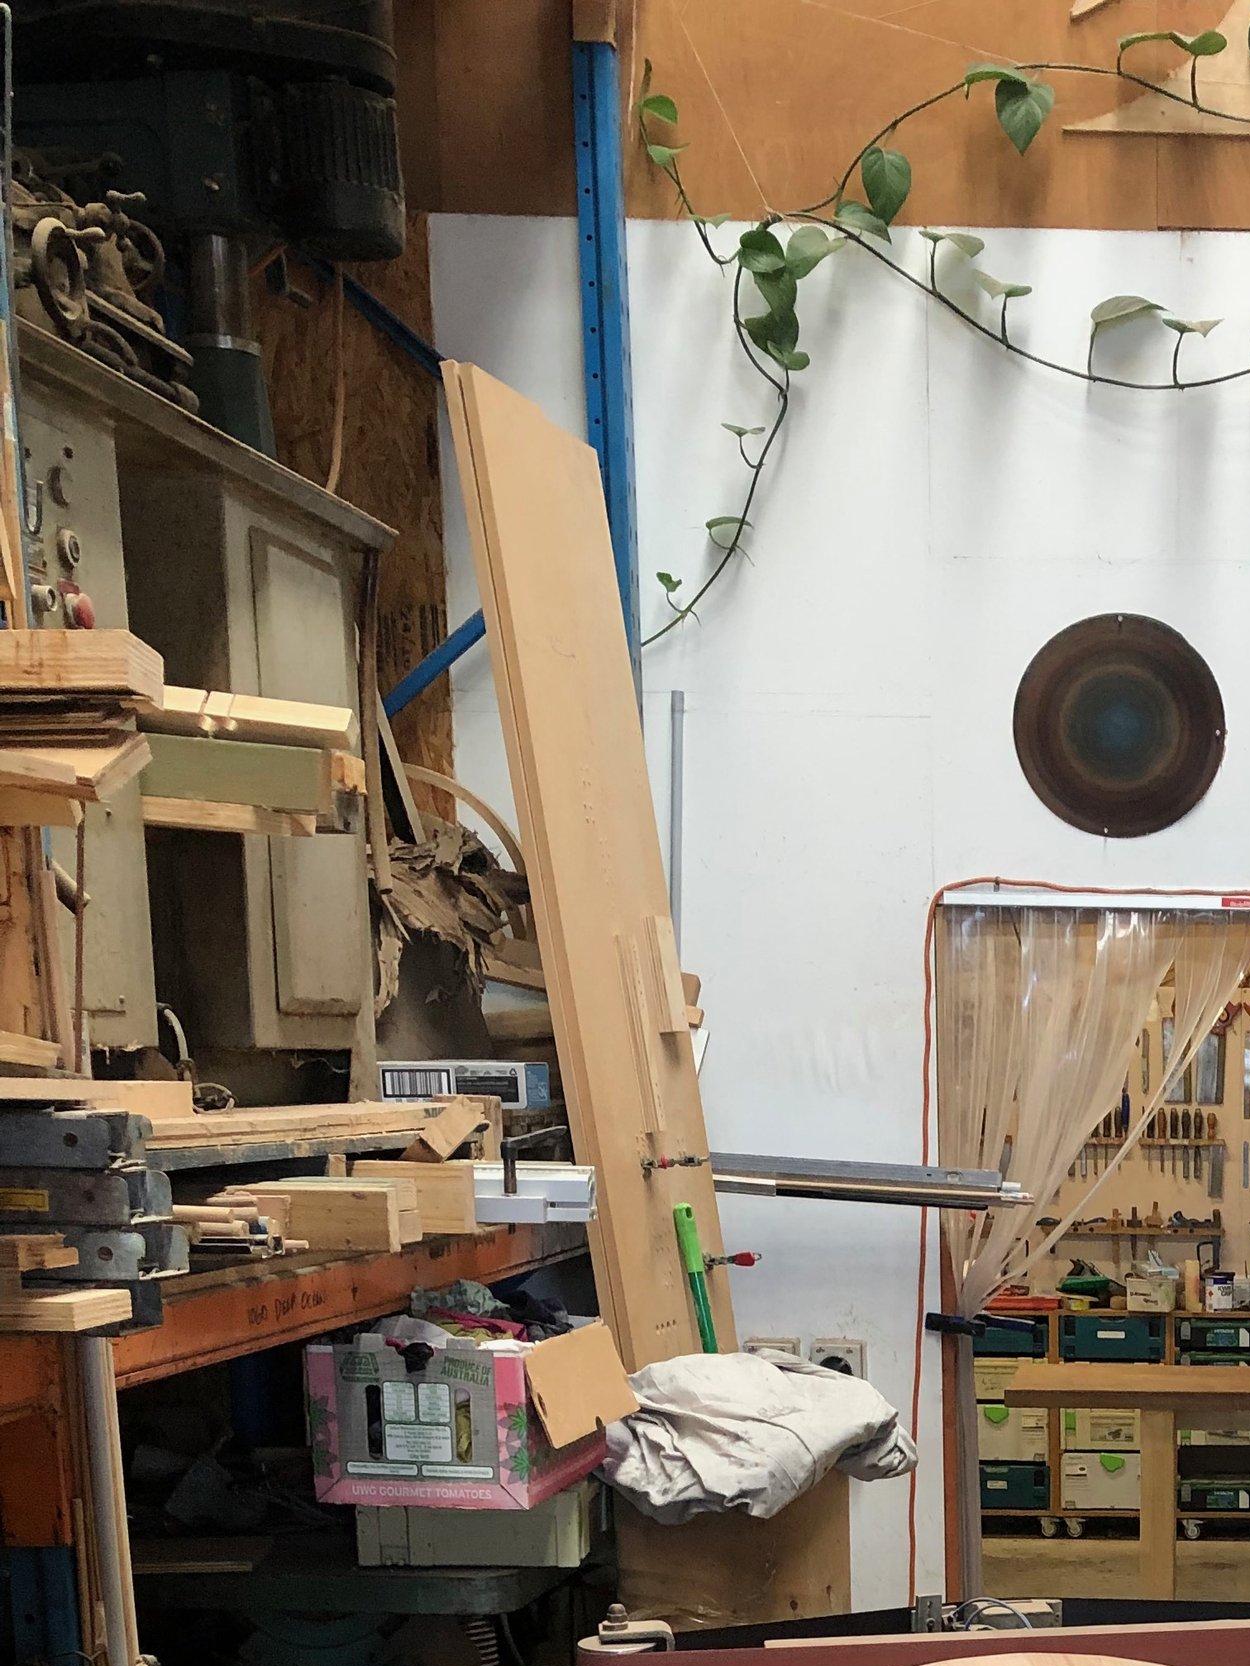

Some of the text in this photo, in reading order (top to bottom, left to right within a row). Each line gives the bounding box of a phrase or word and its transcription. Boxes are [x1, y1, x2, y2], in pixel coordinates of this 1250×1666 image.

[444, 1355, 480, 1371] PRODUCE
[440, 1365, 489, 1387] AUSTRALIA
[379, 1485, 432, 1498] GOURMET
[436, 1487, 492, 1500] TOMATOES
